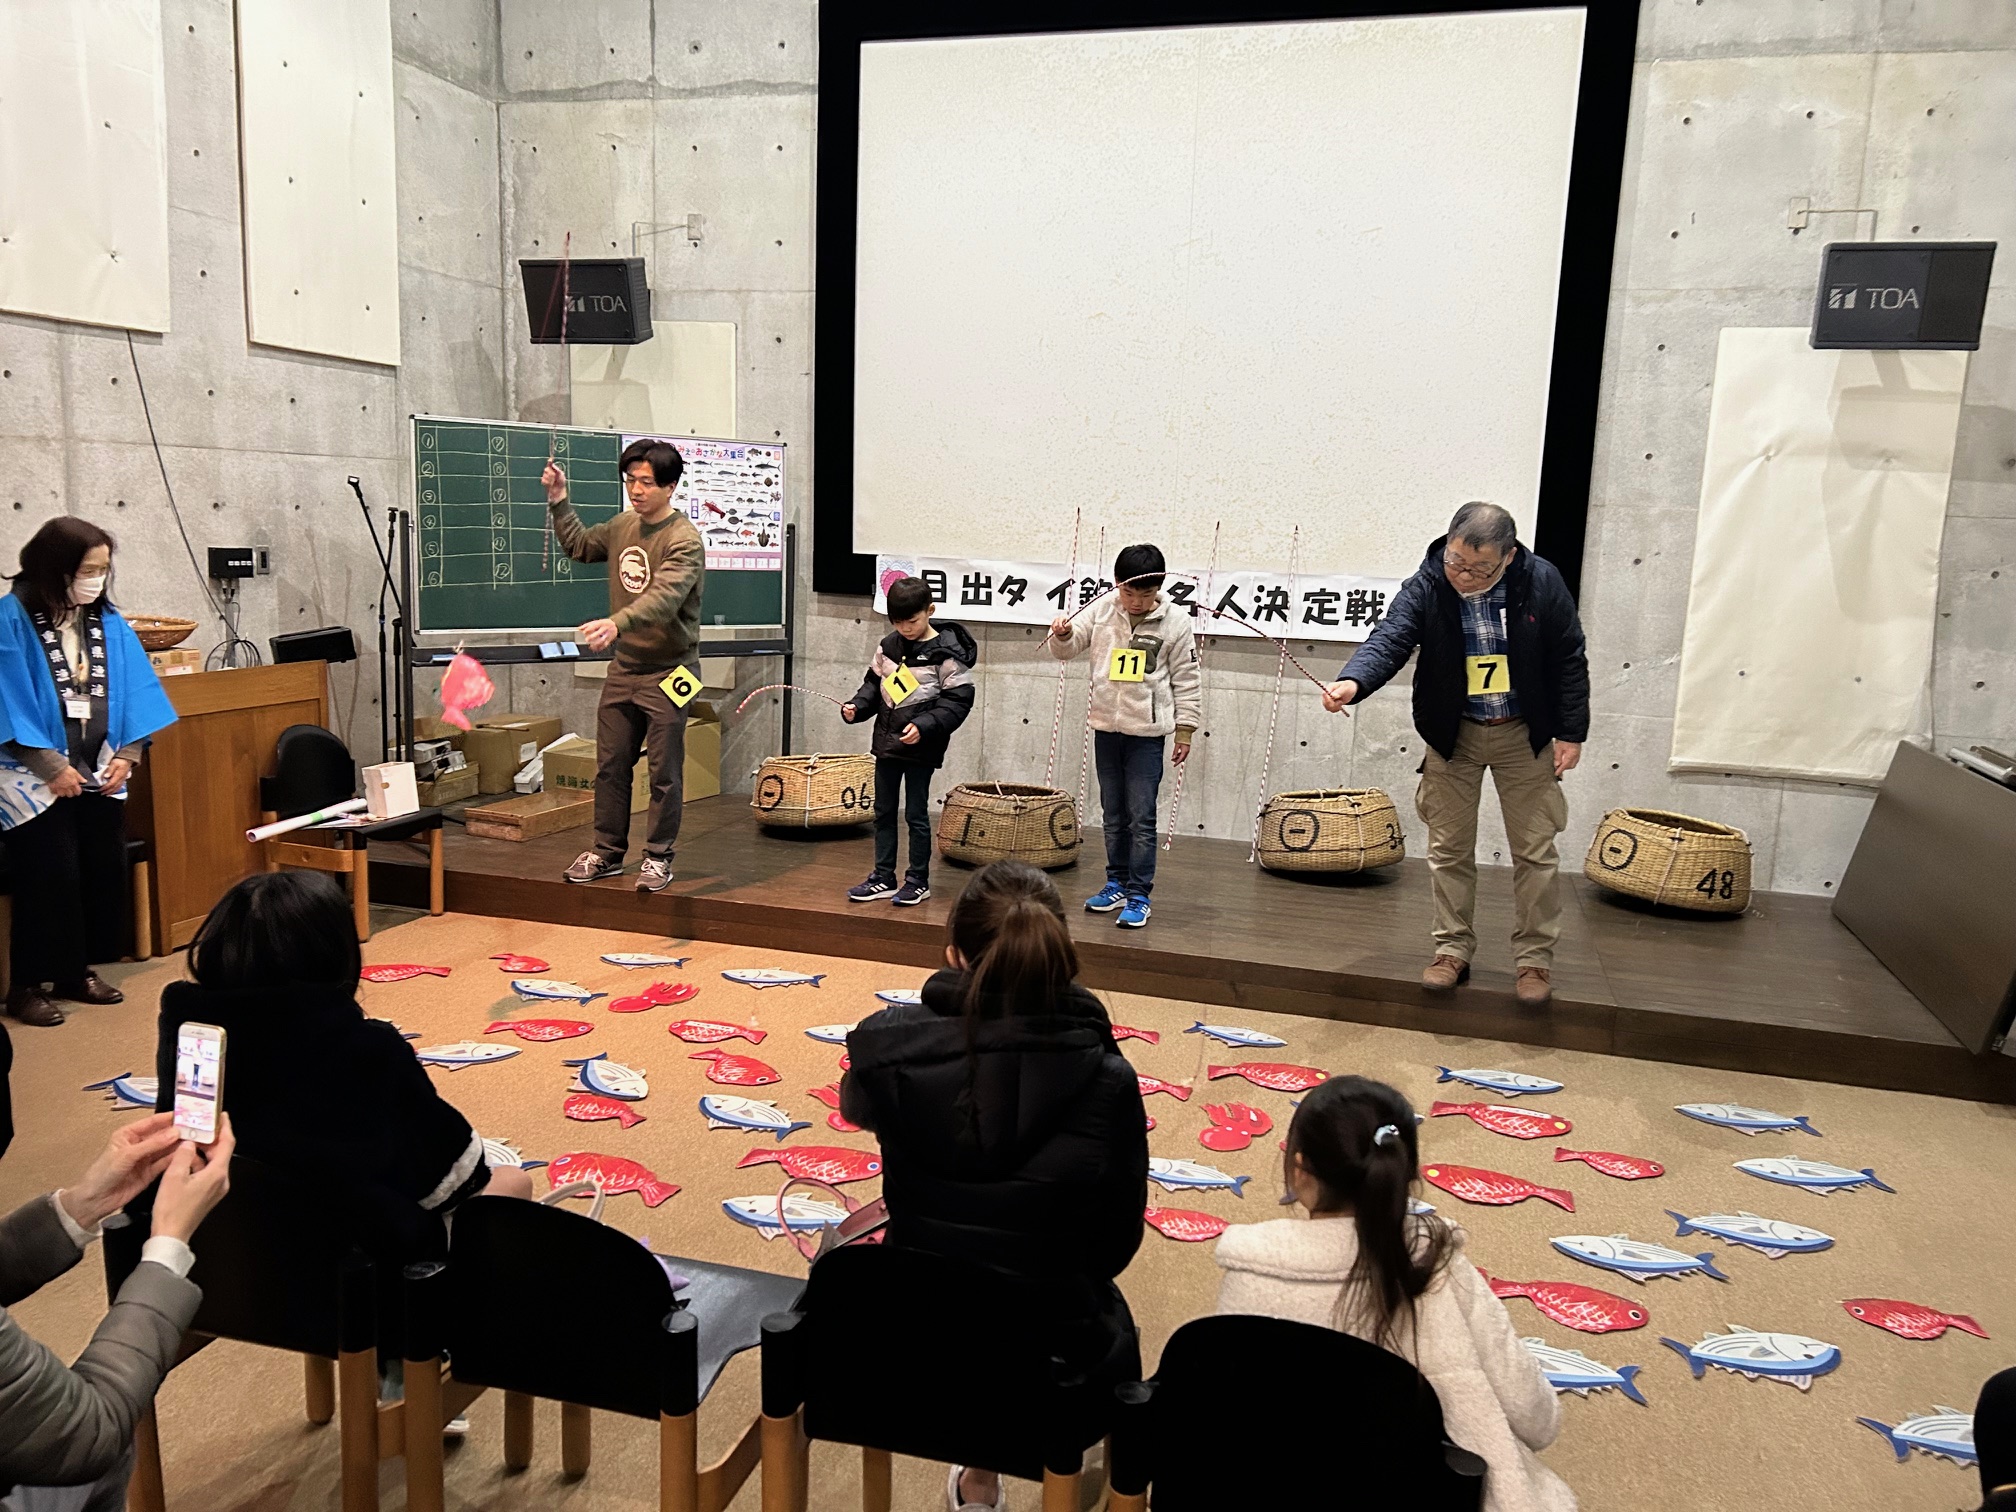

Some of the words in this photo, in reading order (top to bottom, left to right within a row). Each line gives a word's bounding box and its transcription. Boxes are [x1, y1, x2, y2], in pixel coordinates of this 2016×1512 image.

[589, 295, 627, 313] TOA
[1866, 288, 1920, 310] TOA
[1117, 654, 1139, 675] 11
[672, 676, 692, 697] 6
[892, 675, 908, 693] 1
[1477, 662, 1497, 690] 7
[841, 782, 871, 810] 06
[1695, 868, 1735, 900] 48
